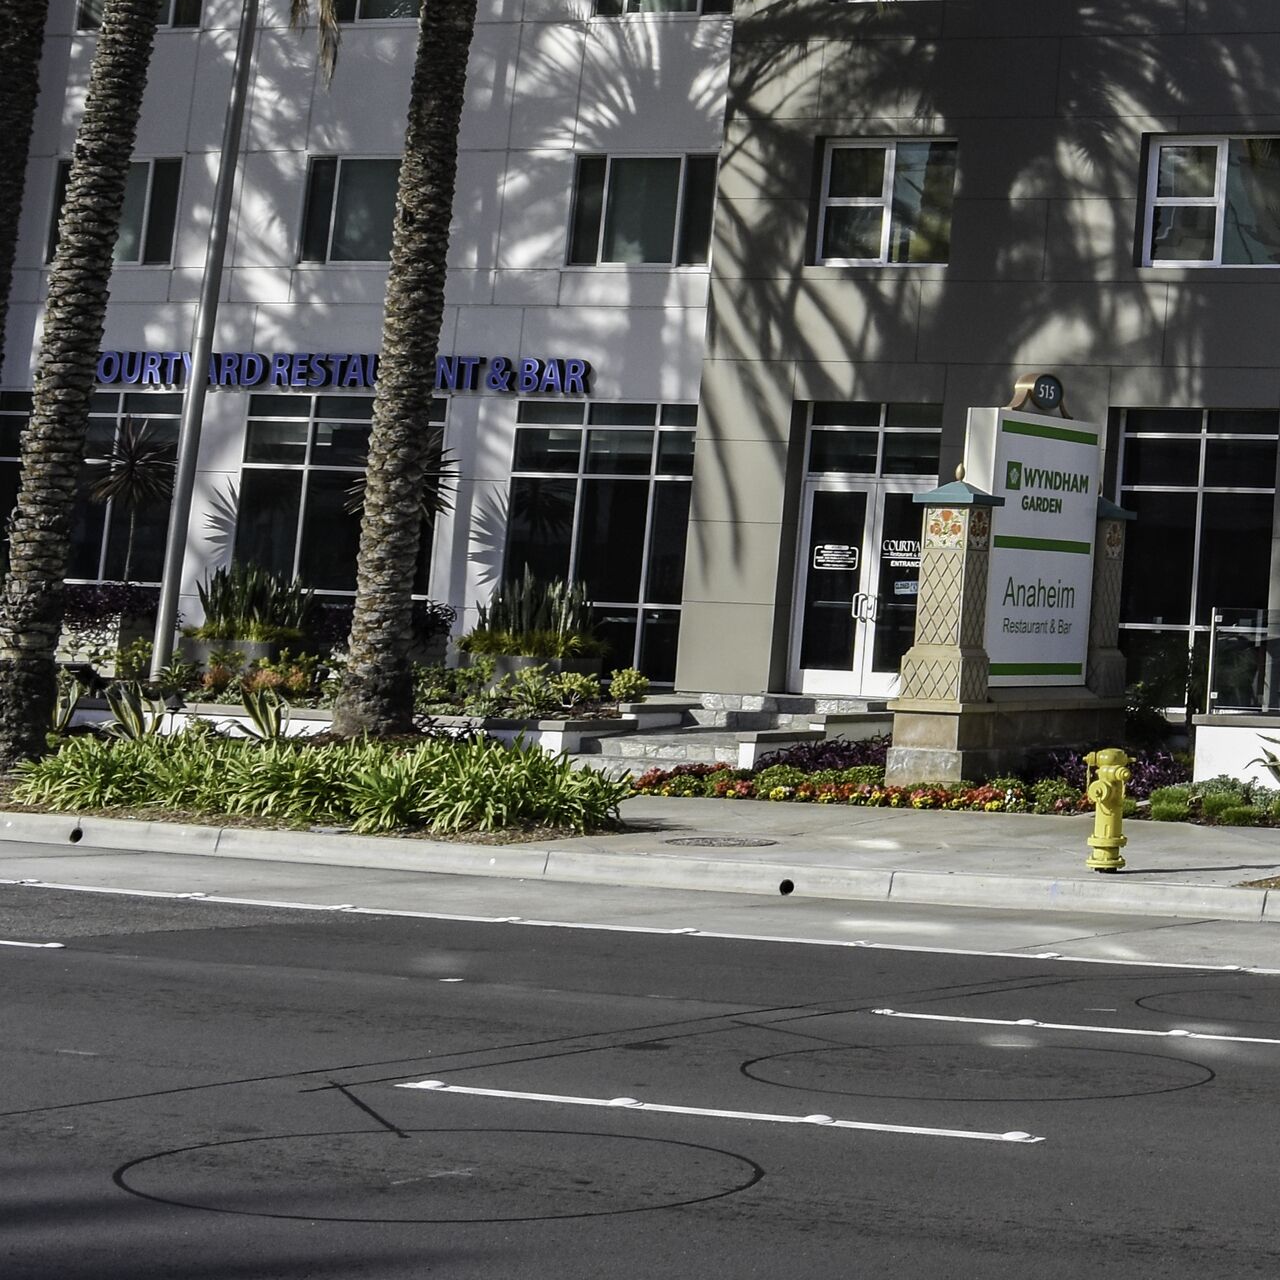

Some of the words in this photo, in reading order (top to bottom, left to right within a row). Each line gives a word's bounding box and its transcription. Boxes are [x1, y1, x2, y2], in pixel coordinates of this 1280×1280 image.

[97, 351, 263, 386] OURTYARD
[270, 352, 482, 391] RESTANT
[486, 356, 510, 392] &
[519, 357, 587, 393] BAR
[1038, 384, 1055, 400] 515
[1024, 467, 1089, 494] WYNDHAM
[1021, 495, 1063, 514] GARDEN
[882, 539, 920, 551] COURTYA
[890, 560, 921, 568] ENTRANC
[1002, 576, 1075, 609] Anaheim
[1002, 617, 1048, 634] Restaurant
[1049, 618, 1056, 634] &
[1057, 619, 1072, 634] Bar
